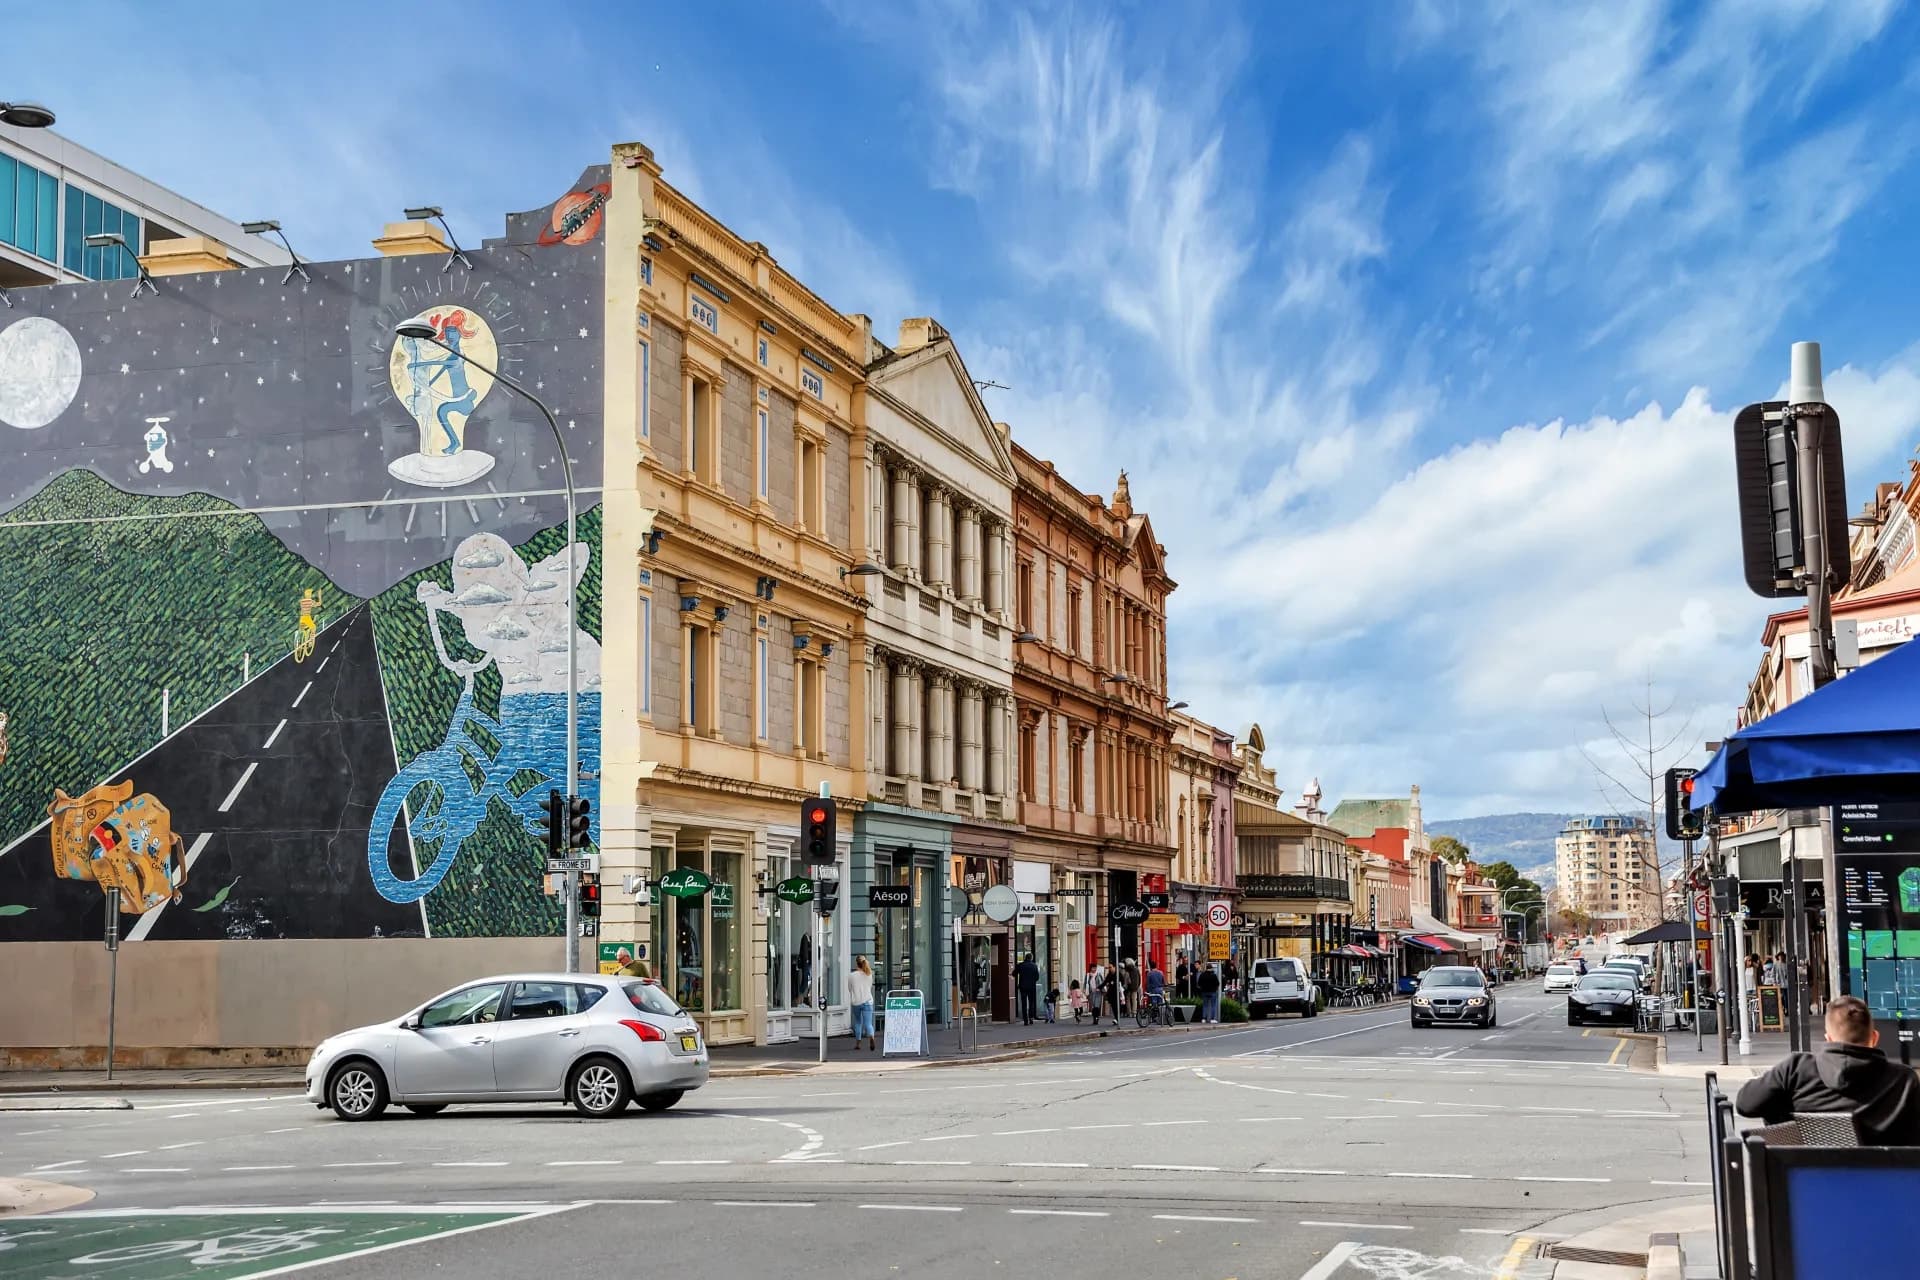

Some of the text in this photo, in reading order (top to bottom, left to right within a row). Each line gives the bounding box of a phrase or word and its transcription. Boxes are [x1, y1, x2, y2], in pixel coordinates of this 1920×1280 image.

[558, 860, 588, 868] FROME ST
[661, 875, 683, 892] Paddy
[777, 883, 814, 899] Paddy Pall
[873, 890, 908, 904] Aēsop
[1023, 904, 1056, 912] MARCS
[1212, 911, 1226, 920] 50
